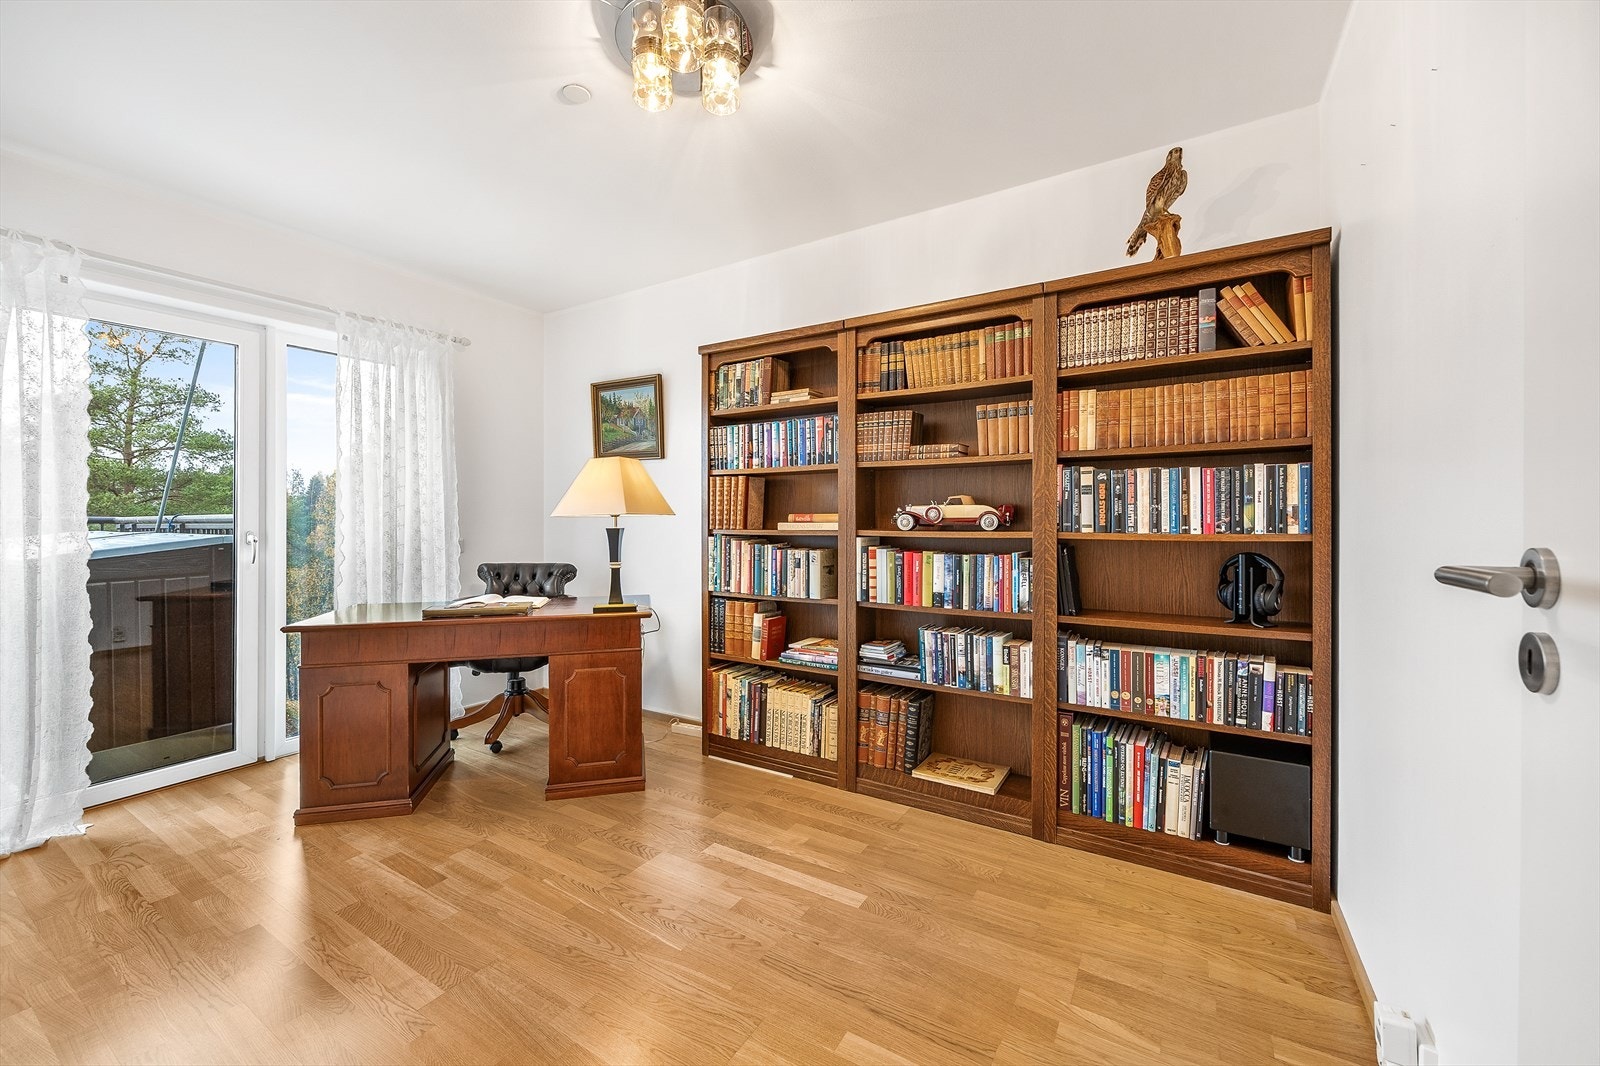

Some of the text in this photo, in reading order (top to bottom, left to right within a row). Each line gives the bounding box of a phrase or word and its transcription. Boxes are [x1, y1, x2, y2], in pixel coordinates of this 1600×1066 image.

[1156, 660, 1164, 685] RILEY
[1059, 788, 1069, 807] VIN
[1184, 774, 1192, 803] IACOCCA
